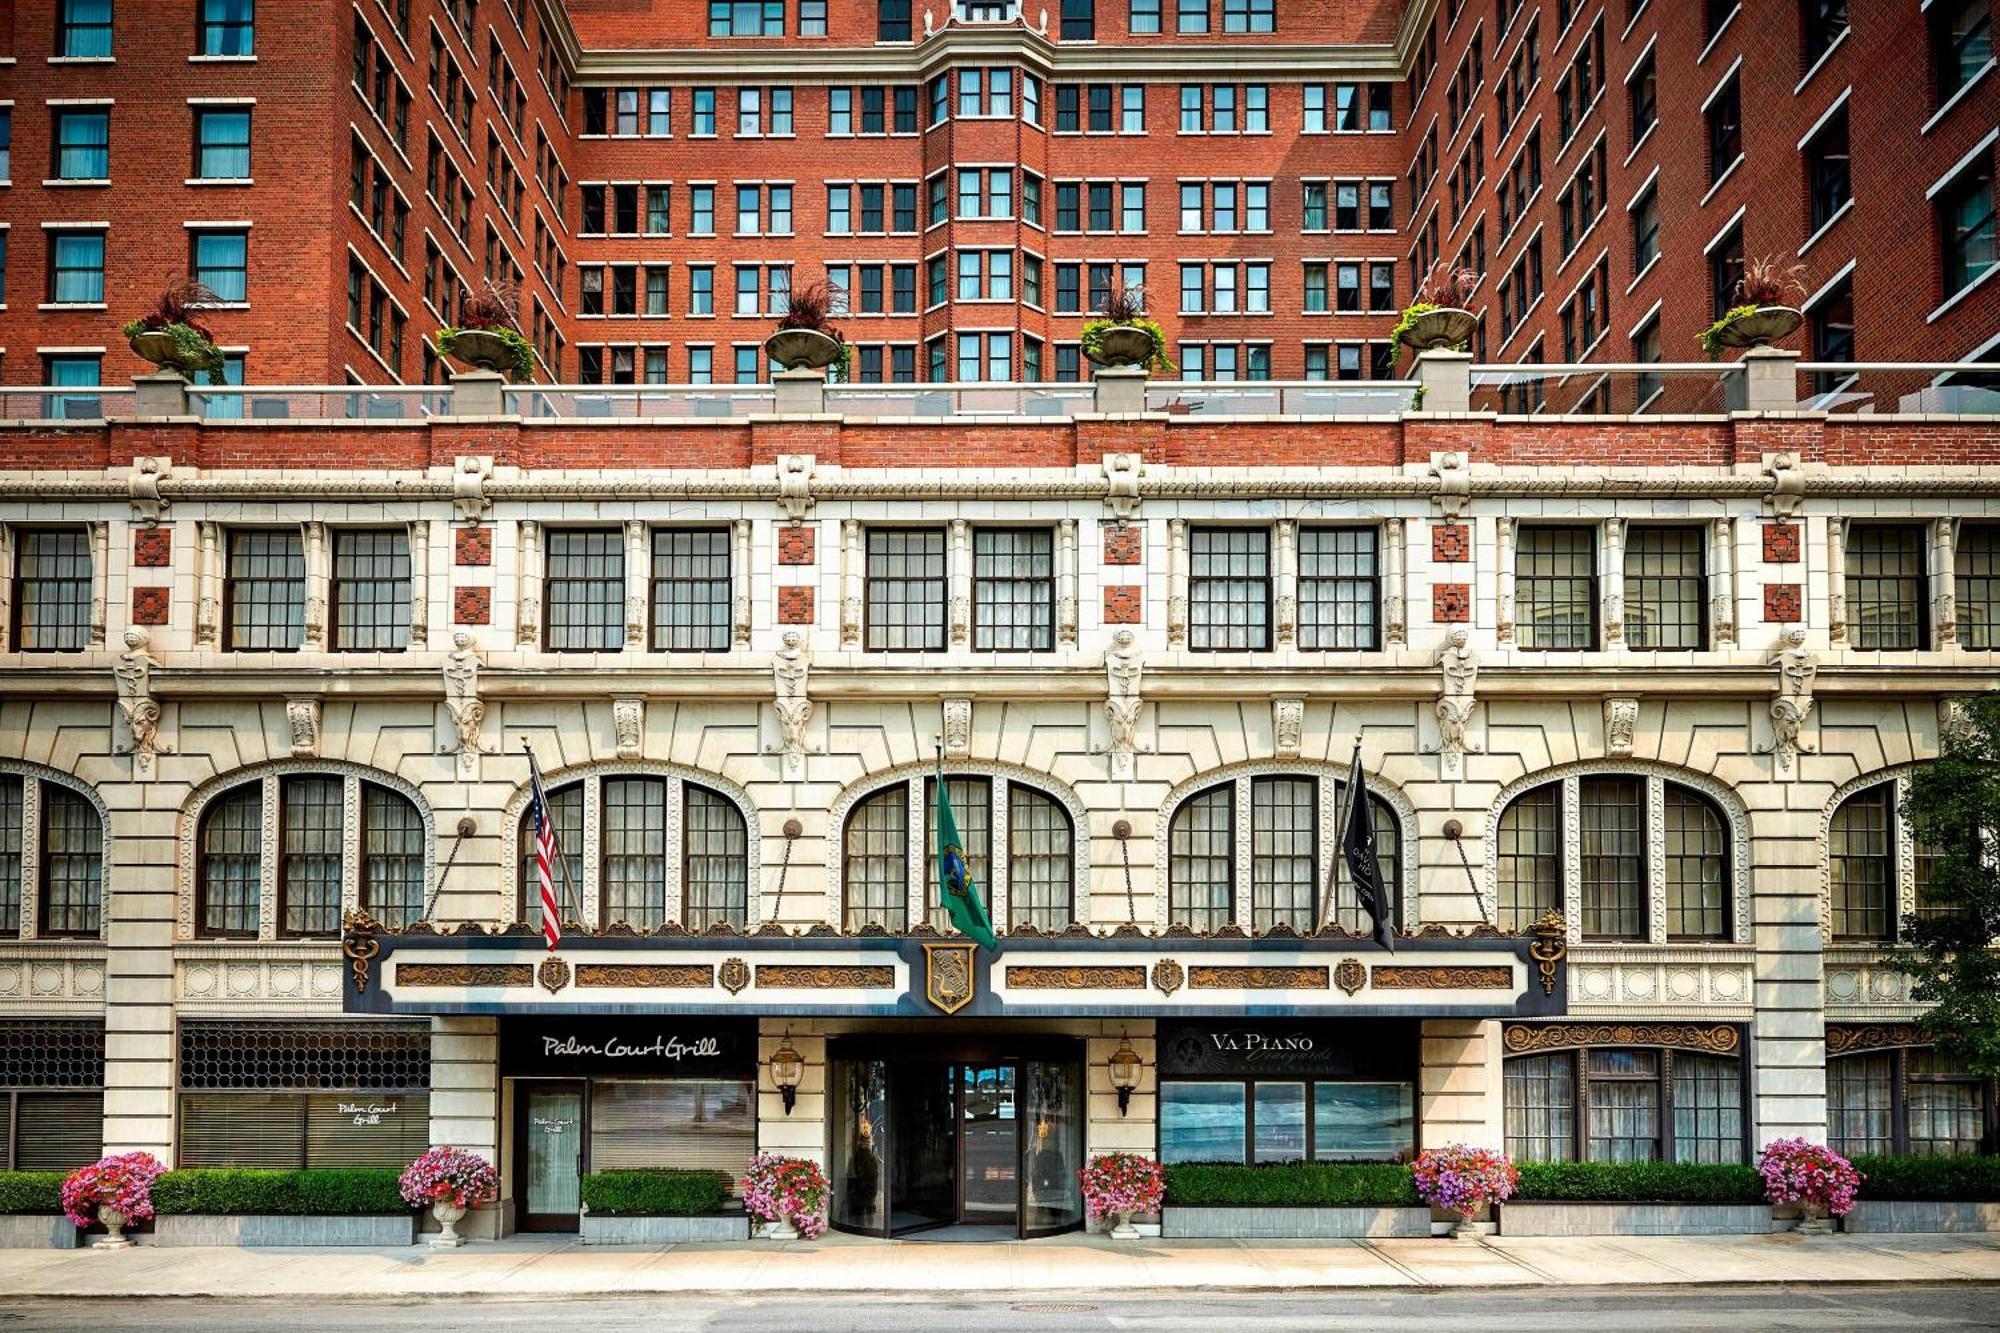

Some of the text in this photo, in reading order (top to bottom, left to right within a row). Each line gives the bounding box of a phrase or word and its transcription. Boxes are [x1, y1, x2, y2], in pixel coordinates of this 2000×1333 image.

[542, 1035, 721, 1061] Palm Court Grill
[338, 1102, 398, 1114] Palm Court
[353, 1114, 382, 1127] Grill
